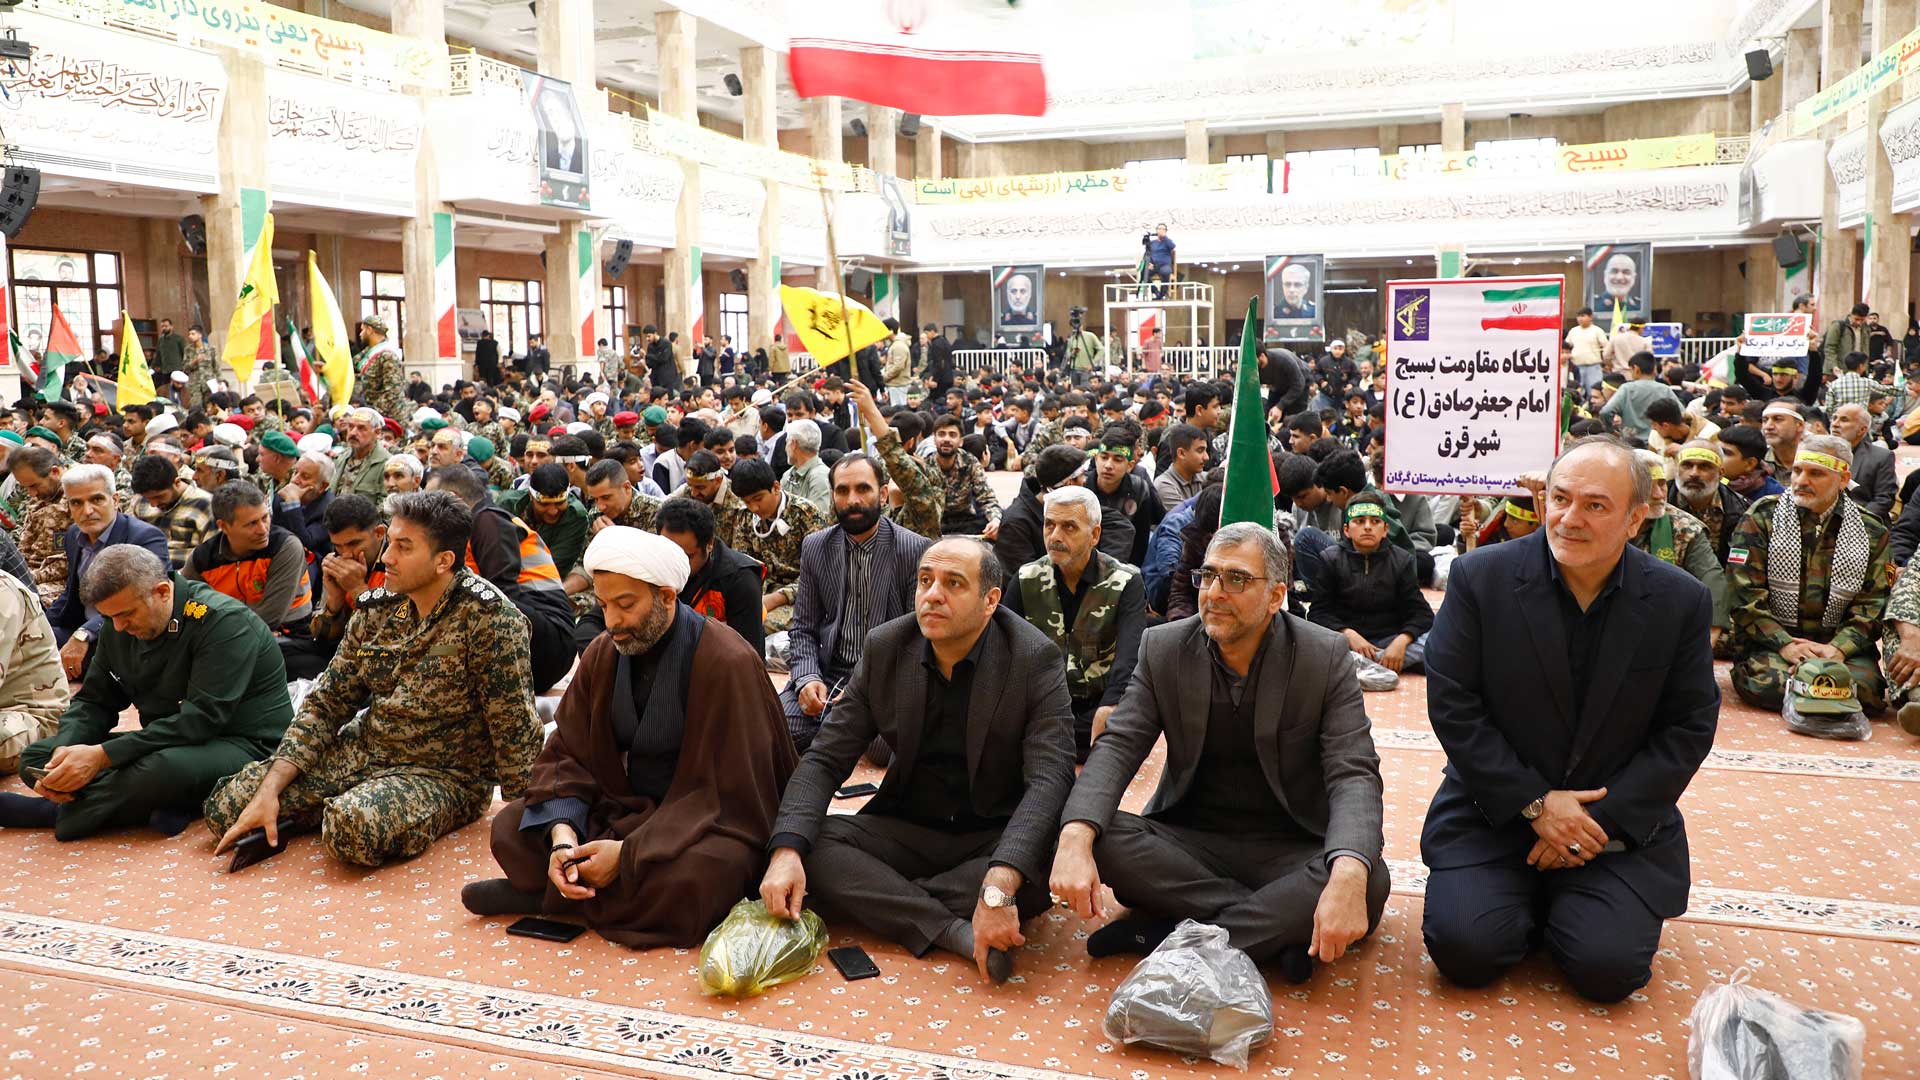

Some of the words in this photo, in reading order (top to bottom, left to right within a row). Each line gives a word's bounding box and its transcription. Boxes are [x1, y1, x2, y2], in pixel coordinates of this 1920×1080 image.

[202, 5, 261, 47] نیروی
[265, 14, 309, 55] یعنی
[310, 28, 366, 68] بسیج
[1562, 147, 1628, 172] بسیج
[922, 181, 956, 195] است
[959, 180, 993, 199] الهی
[996, 175, 1062, 197] ارزشهای
[1065, 174, 1110, 194] مظهر
[1395, 355, 1436, 380] بسیج
[1439, 349, 1499, 381] مقاومت
[1502, 347, 1550, 383] پایگاه
[1427, 388, 1479, 420] صادق
[1470, 388, 1513, 420] جعفر
[1516, 388, 1551, 421] امام
[1437, 425, 1470, 459] قرق
[1468, 427, 1501, 459] شهر
[1386, 469, 1412, 485] گرگان
[1411, 472, 1454, 487] شهرستان
[1454, 473, 1479, 488] ناحیه
[1478, 474, 1503, 491] سپاه
[1501, 477, 1518, 490] دیر
